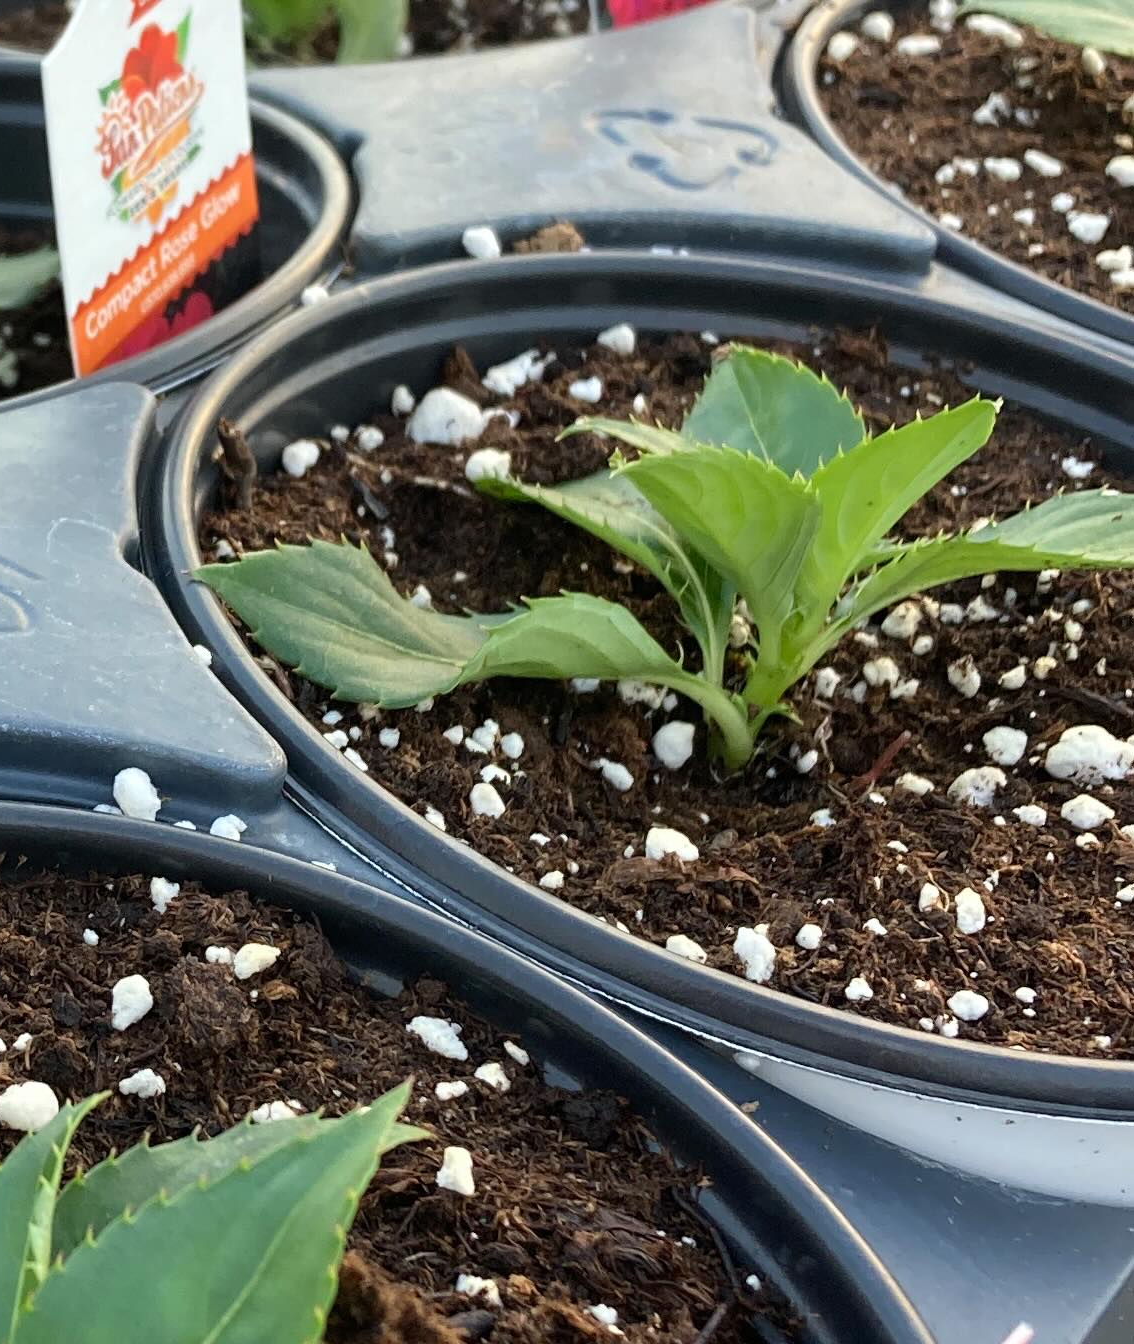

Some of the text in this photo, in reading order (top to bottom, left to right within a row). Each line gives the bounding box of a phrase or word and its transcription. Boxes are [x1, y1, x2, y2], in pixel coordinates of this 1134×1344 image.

[85, 256, 158, 339] Compact
[159, 222, 199, 269] Rose
[200, 182, 241, 229] Glow
